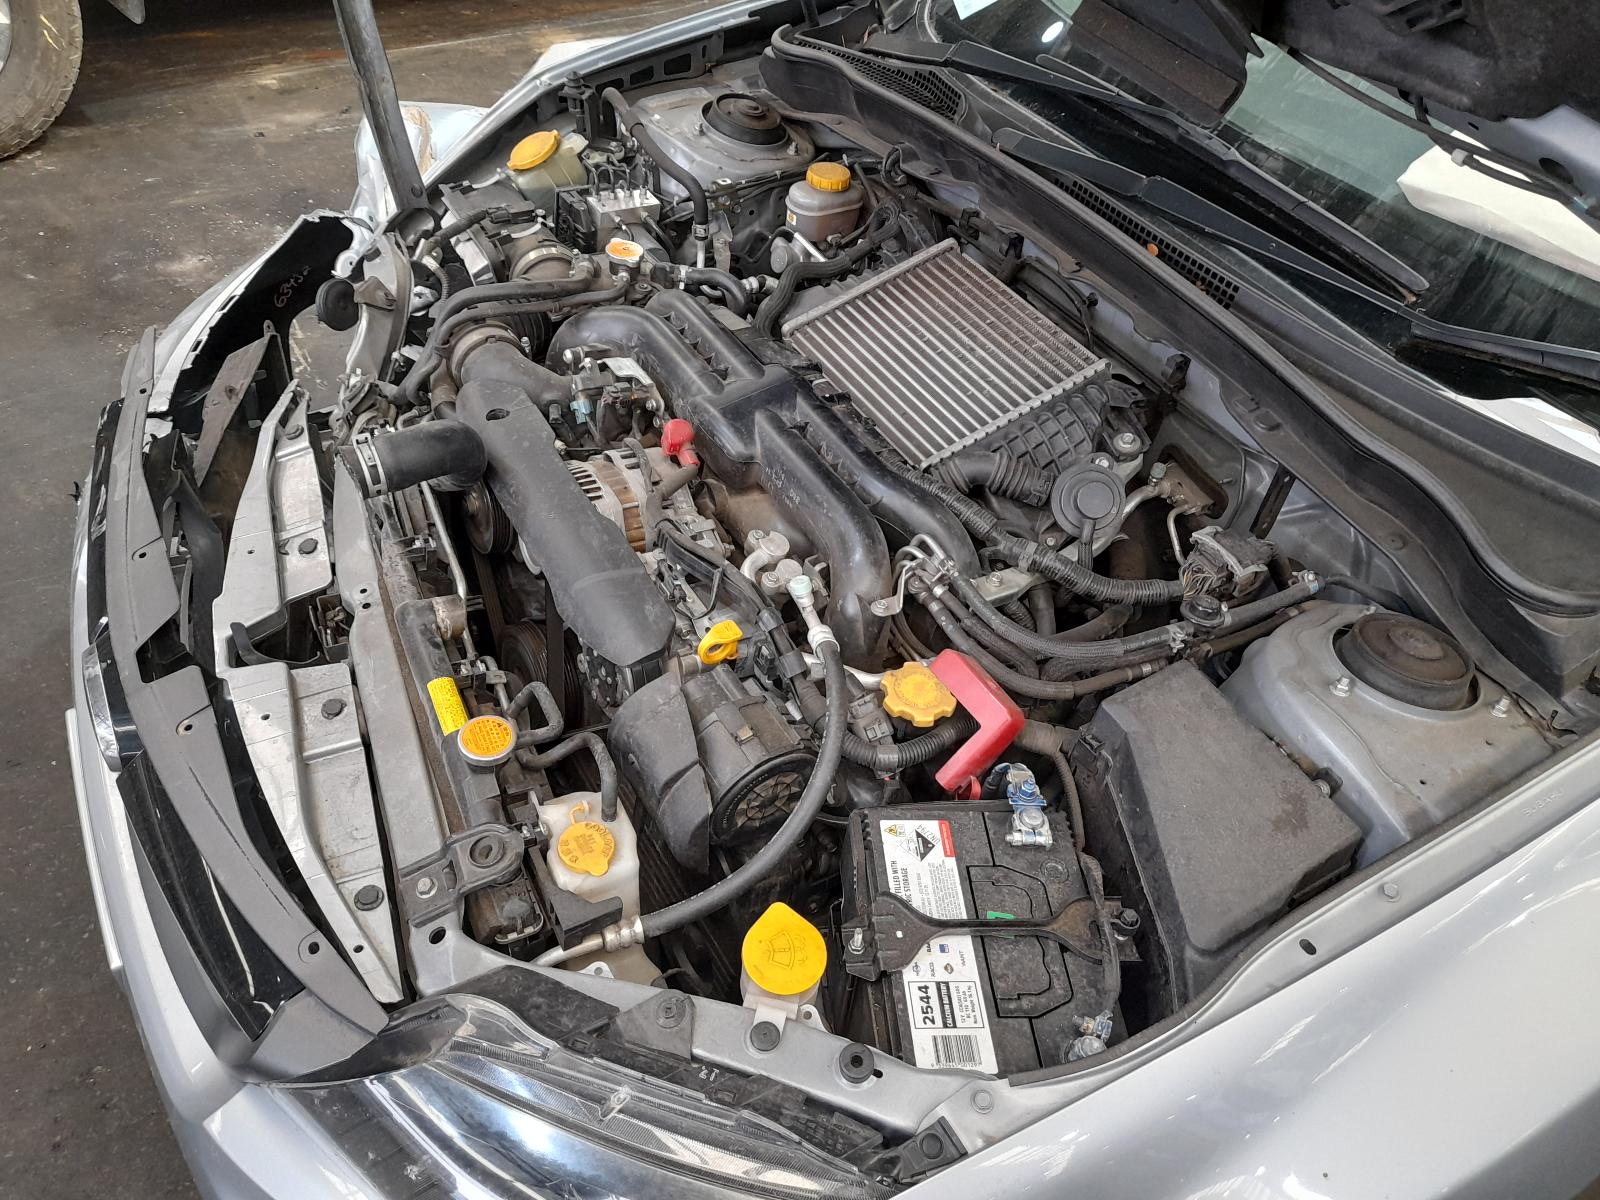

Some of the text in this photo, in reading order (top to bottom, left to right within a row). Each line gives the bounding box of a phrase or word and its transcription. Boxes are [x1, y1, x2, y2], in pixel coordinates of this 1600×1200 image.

[894, 875, 902, 893] FILLED
[901, 868, 911, 892] STORAGE
[940, 982, 950, 1004] BATTERY
[917, 985, 935, 1025] 2544
[944, 1005, 954, 1027] CALCIUM
